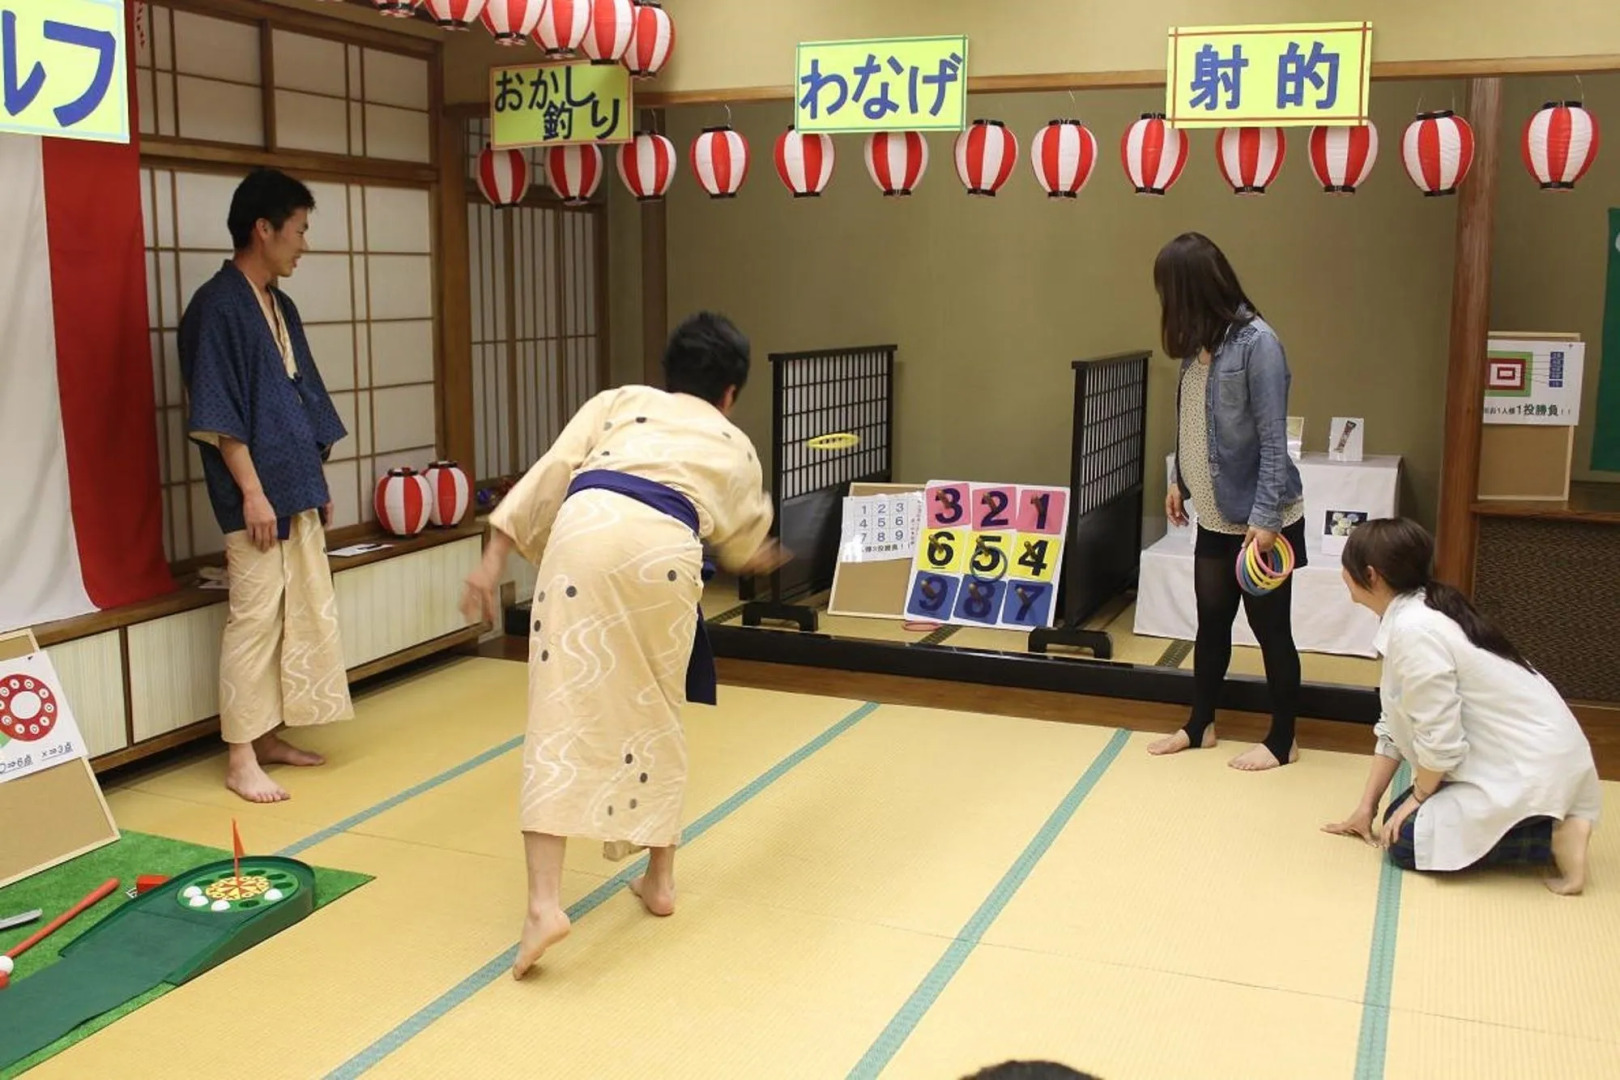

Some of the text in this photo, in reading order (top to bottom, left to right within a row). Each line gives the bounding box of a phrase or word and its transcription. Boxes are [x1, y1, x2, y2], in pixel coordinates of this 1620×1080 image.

[799, 52, 963, 120] わなげ
[1189, 41, 1340, 110] 射的
[859, 516, 904, 528] 4 5 6
[877, 504, 886, 514] 2
[895, 502, 904, 513] 3
[935, 487, 963, 524] 3
[981, 491, 1009, 527] 2
[1031, 493, 1050, 530] 1
[877, 532, 886, 542] 8
[895, 530, 904, 541] 9
[927, 531, 1049, 576] 6 5 4
[918, 576, 1045, 621] 9 8 7
